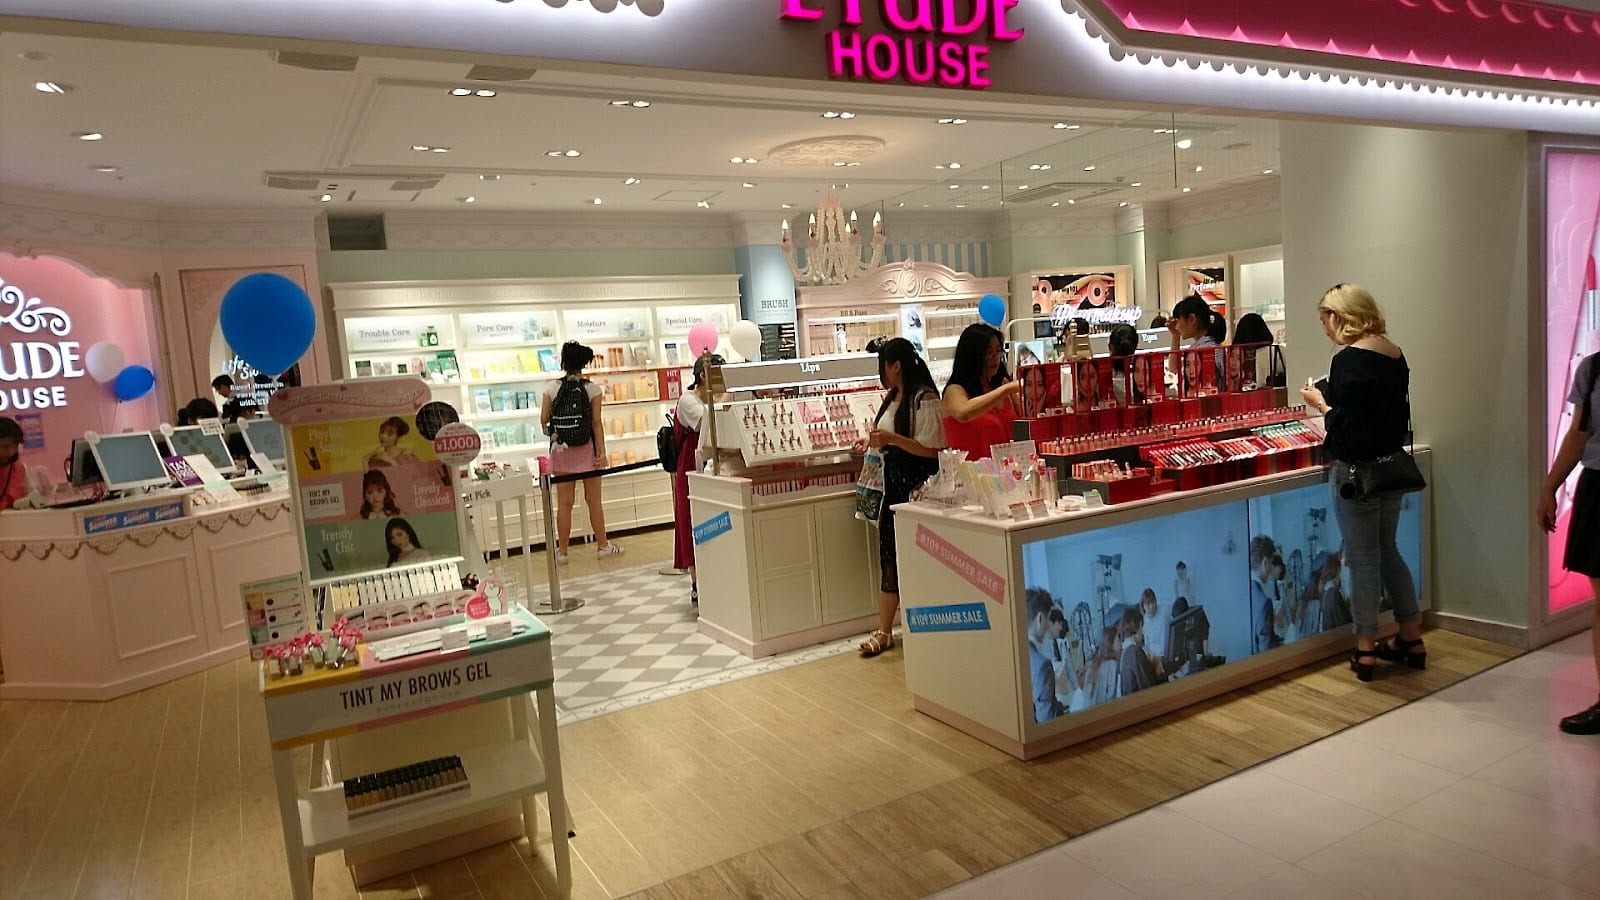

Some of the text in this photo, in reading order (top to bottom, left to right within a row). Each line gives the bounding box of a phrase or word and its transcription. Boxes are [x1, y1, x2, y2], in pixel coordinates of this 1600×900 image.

[829, 30, 991, 88] HOUSE
[760, 299, 788, 309] BRUSH
[476, 325, 495, 333] Pore
[577, 320, 606, 329] Moisture
[359, 328, 411, 338] Trouble Care
[801, 362, 820, 374] Lips
[413, 481, 441, 498] Lovely
[475, 490, 491, 501] Pick
[415, 492, 450, 508] Classical
[321, 526, 353, 543] Trendy
[335, 540, 355, 555] Chic
[920, 532, 999, 593] #109 SUMMER SALE
[911, 610, 984, 626] #109 SUMMER SALE
[339, 685, 374, 710] TINT
[380, 680, 402, 702] MY
[408, 667, 462, 697] BROWS
[466, 661, 492, 683] GEL
